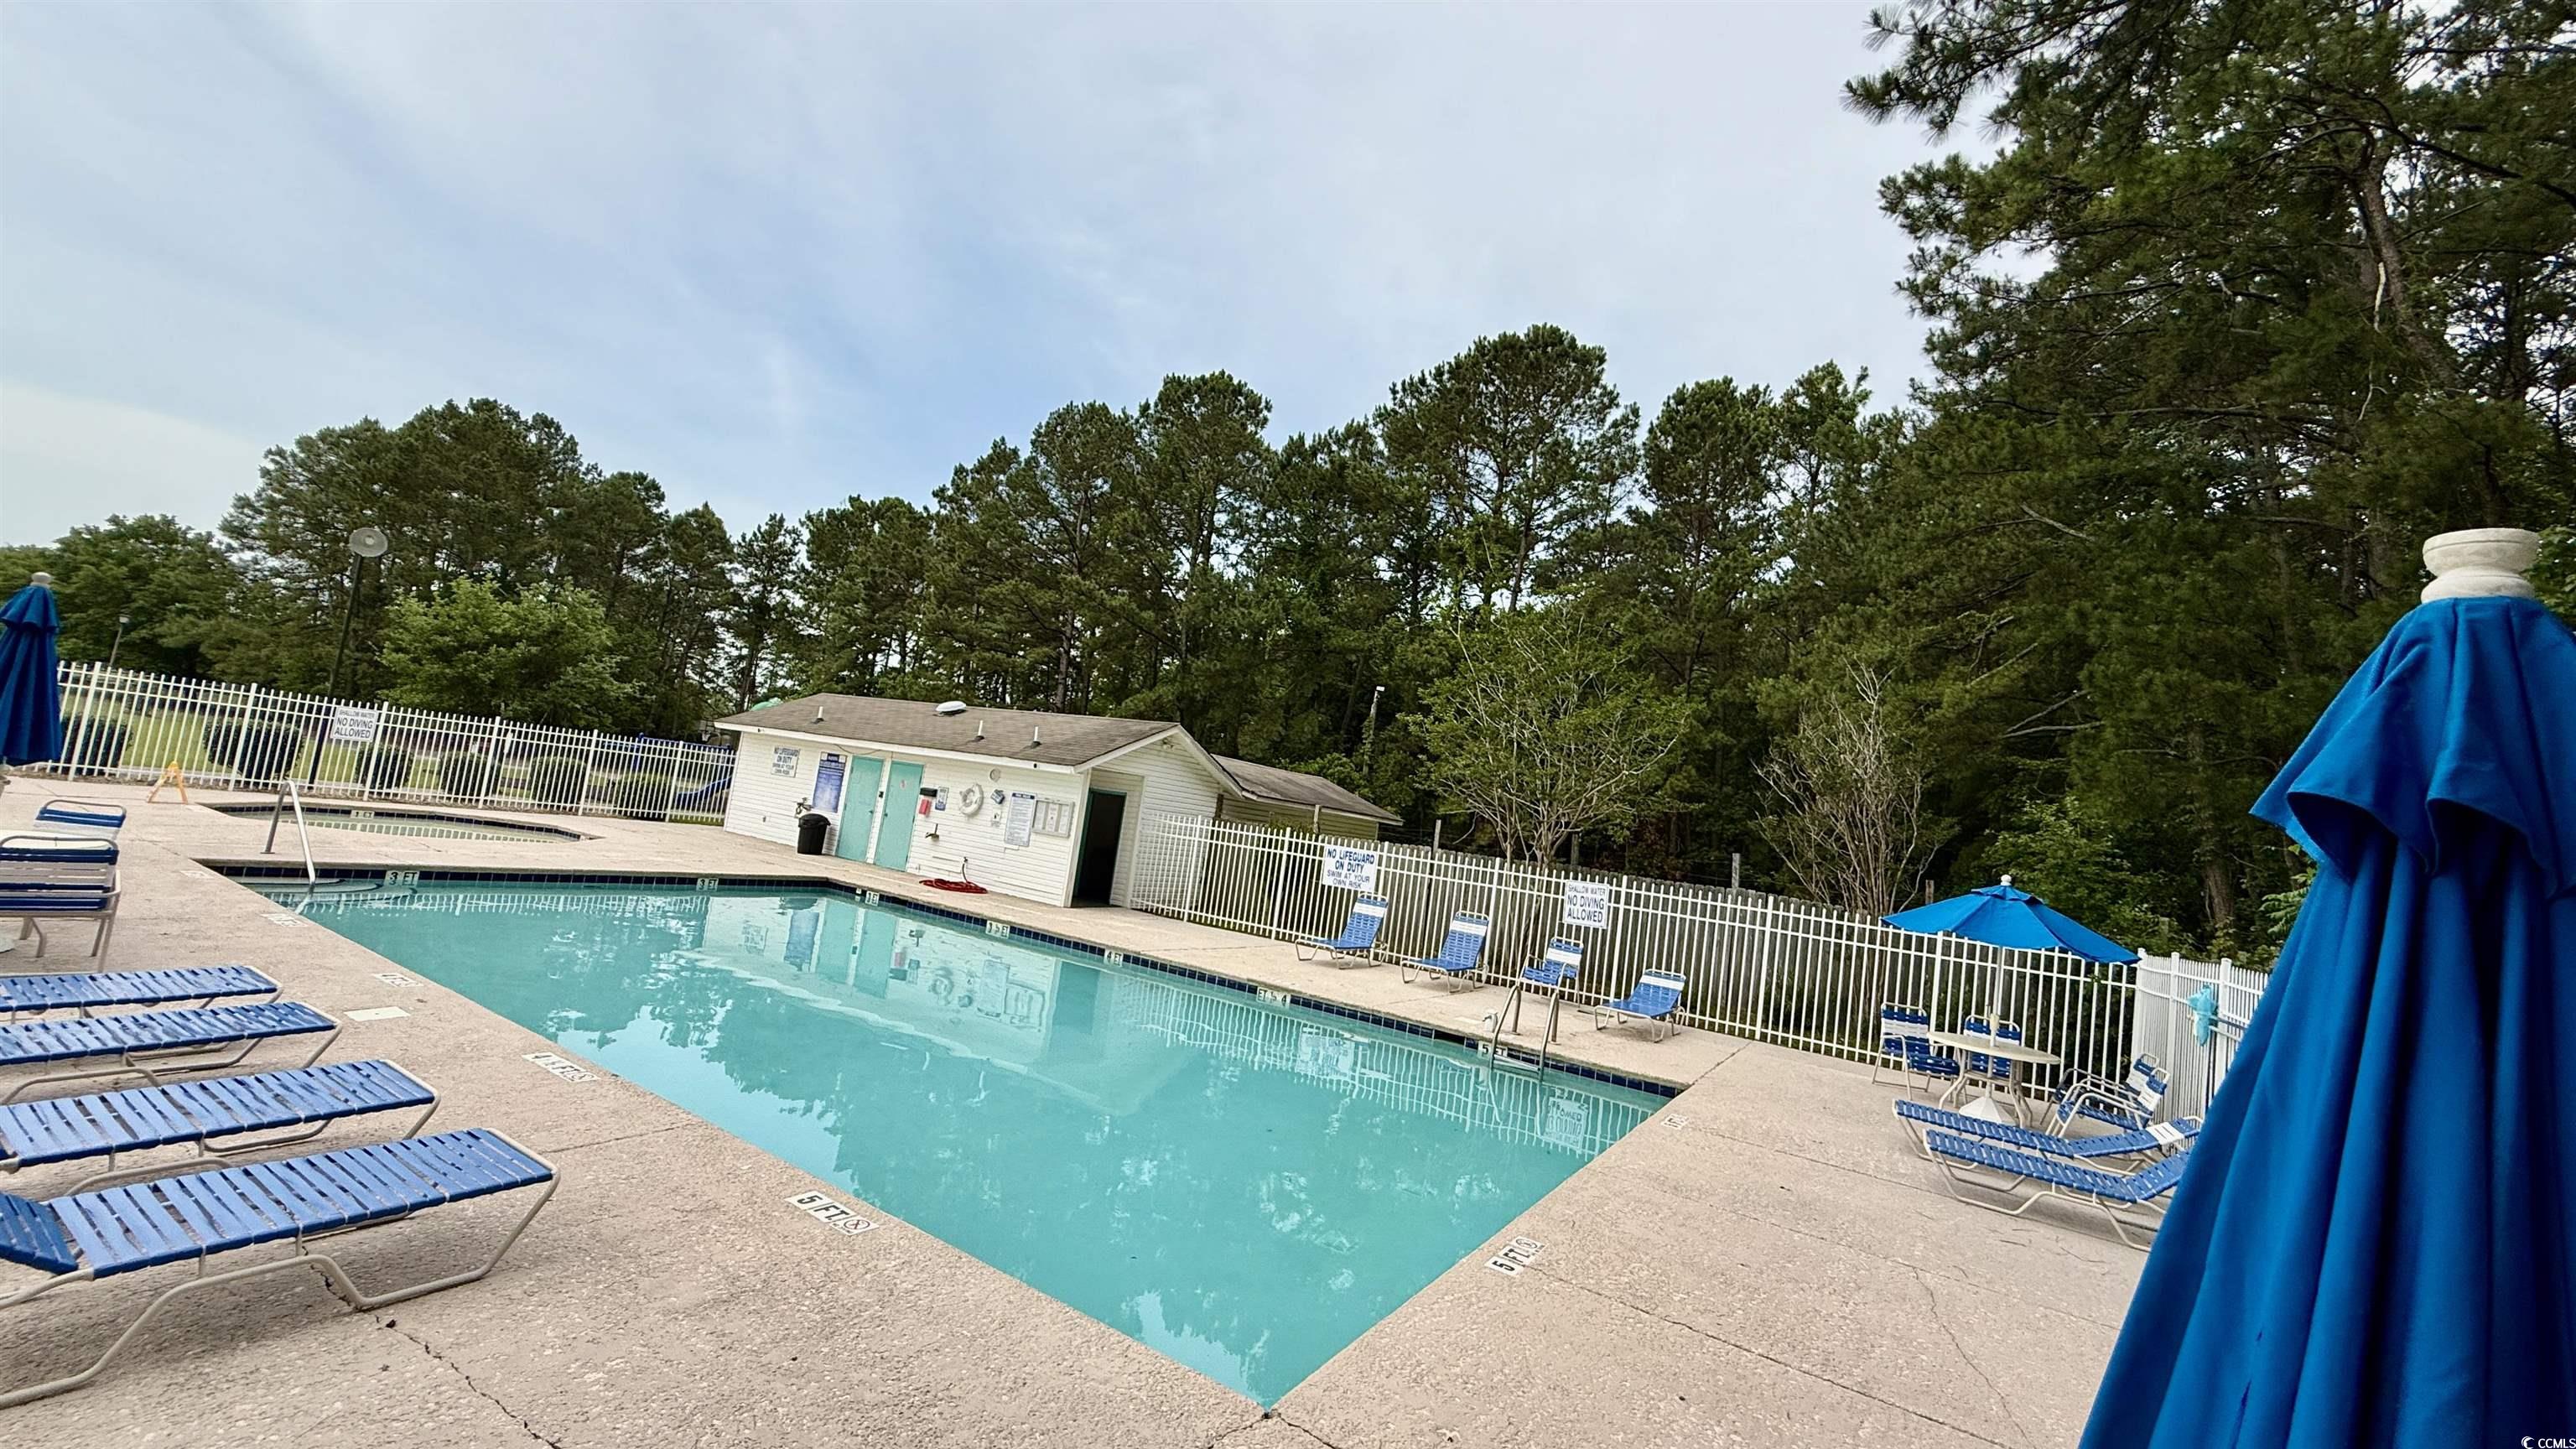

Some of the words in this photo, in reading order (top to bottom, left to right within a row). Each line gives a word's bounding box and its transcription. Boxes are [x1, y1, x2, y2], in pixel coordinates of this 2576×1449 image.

[337, 717, 348, 726] NO
[349, 718, 373, 730] DIVING
[335, 727, 371, 739] ALLOWED
[1327, 849, 1337, 859] NO
[1339, 850, 1375, 865] LIFEGUARD
[1335, 860, 1344, 870] ON
[1347, 862, 1364, 874] DUTY
[1327, 870, 1342, 878] SWIM
[1354, 874, 1370, 883] YOUR
[1332, 878, 1346, 886] OWN
[1348, 880, 1363, 889] RISK
[1568, 884, 1589, 894] SHALLOW
[1590, 887, 1606, 896] WATER
[1567, 895, 1577, 906] NO
[1580, 896, 1604, 910] DIVING
[1566, 907, 1603, 922] ALLOWED
[1482, 1044, 1489, 1054] 5
[797, 1195, 823, 1205] 5
[1492, 1260, 1515, 1272] 5
